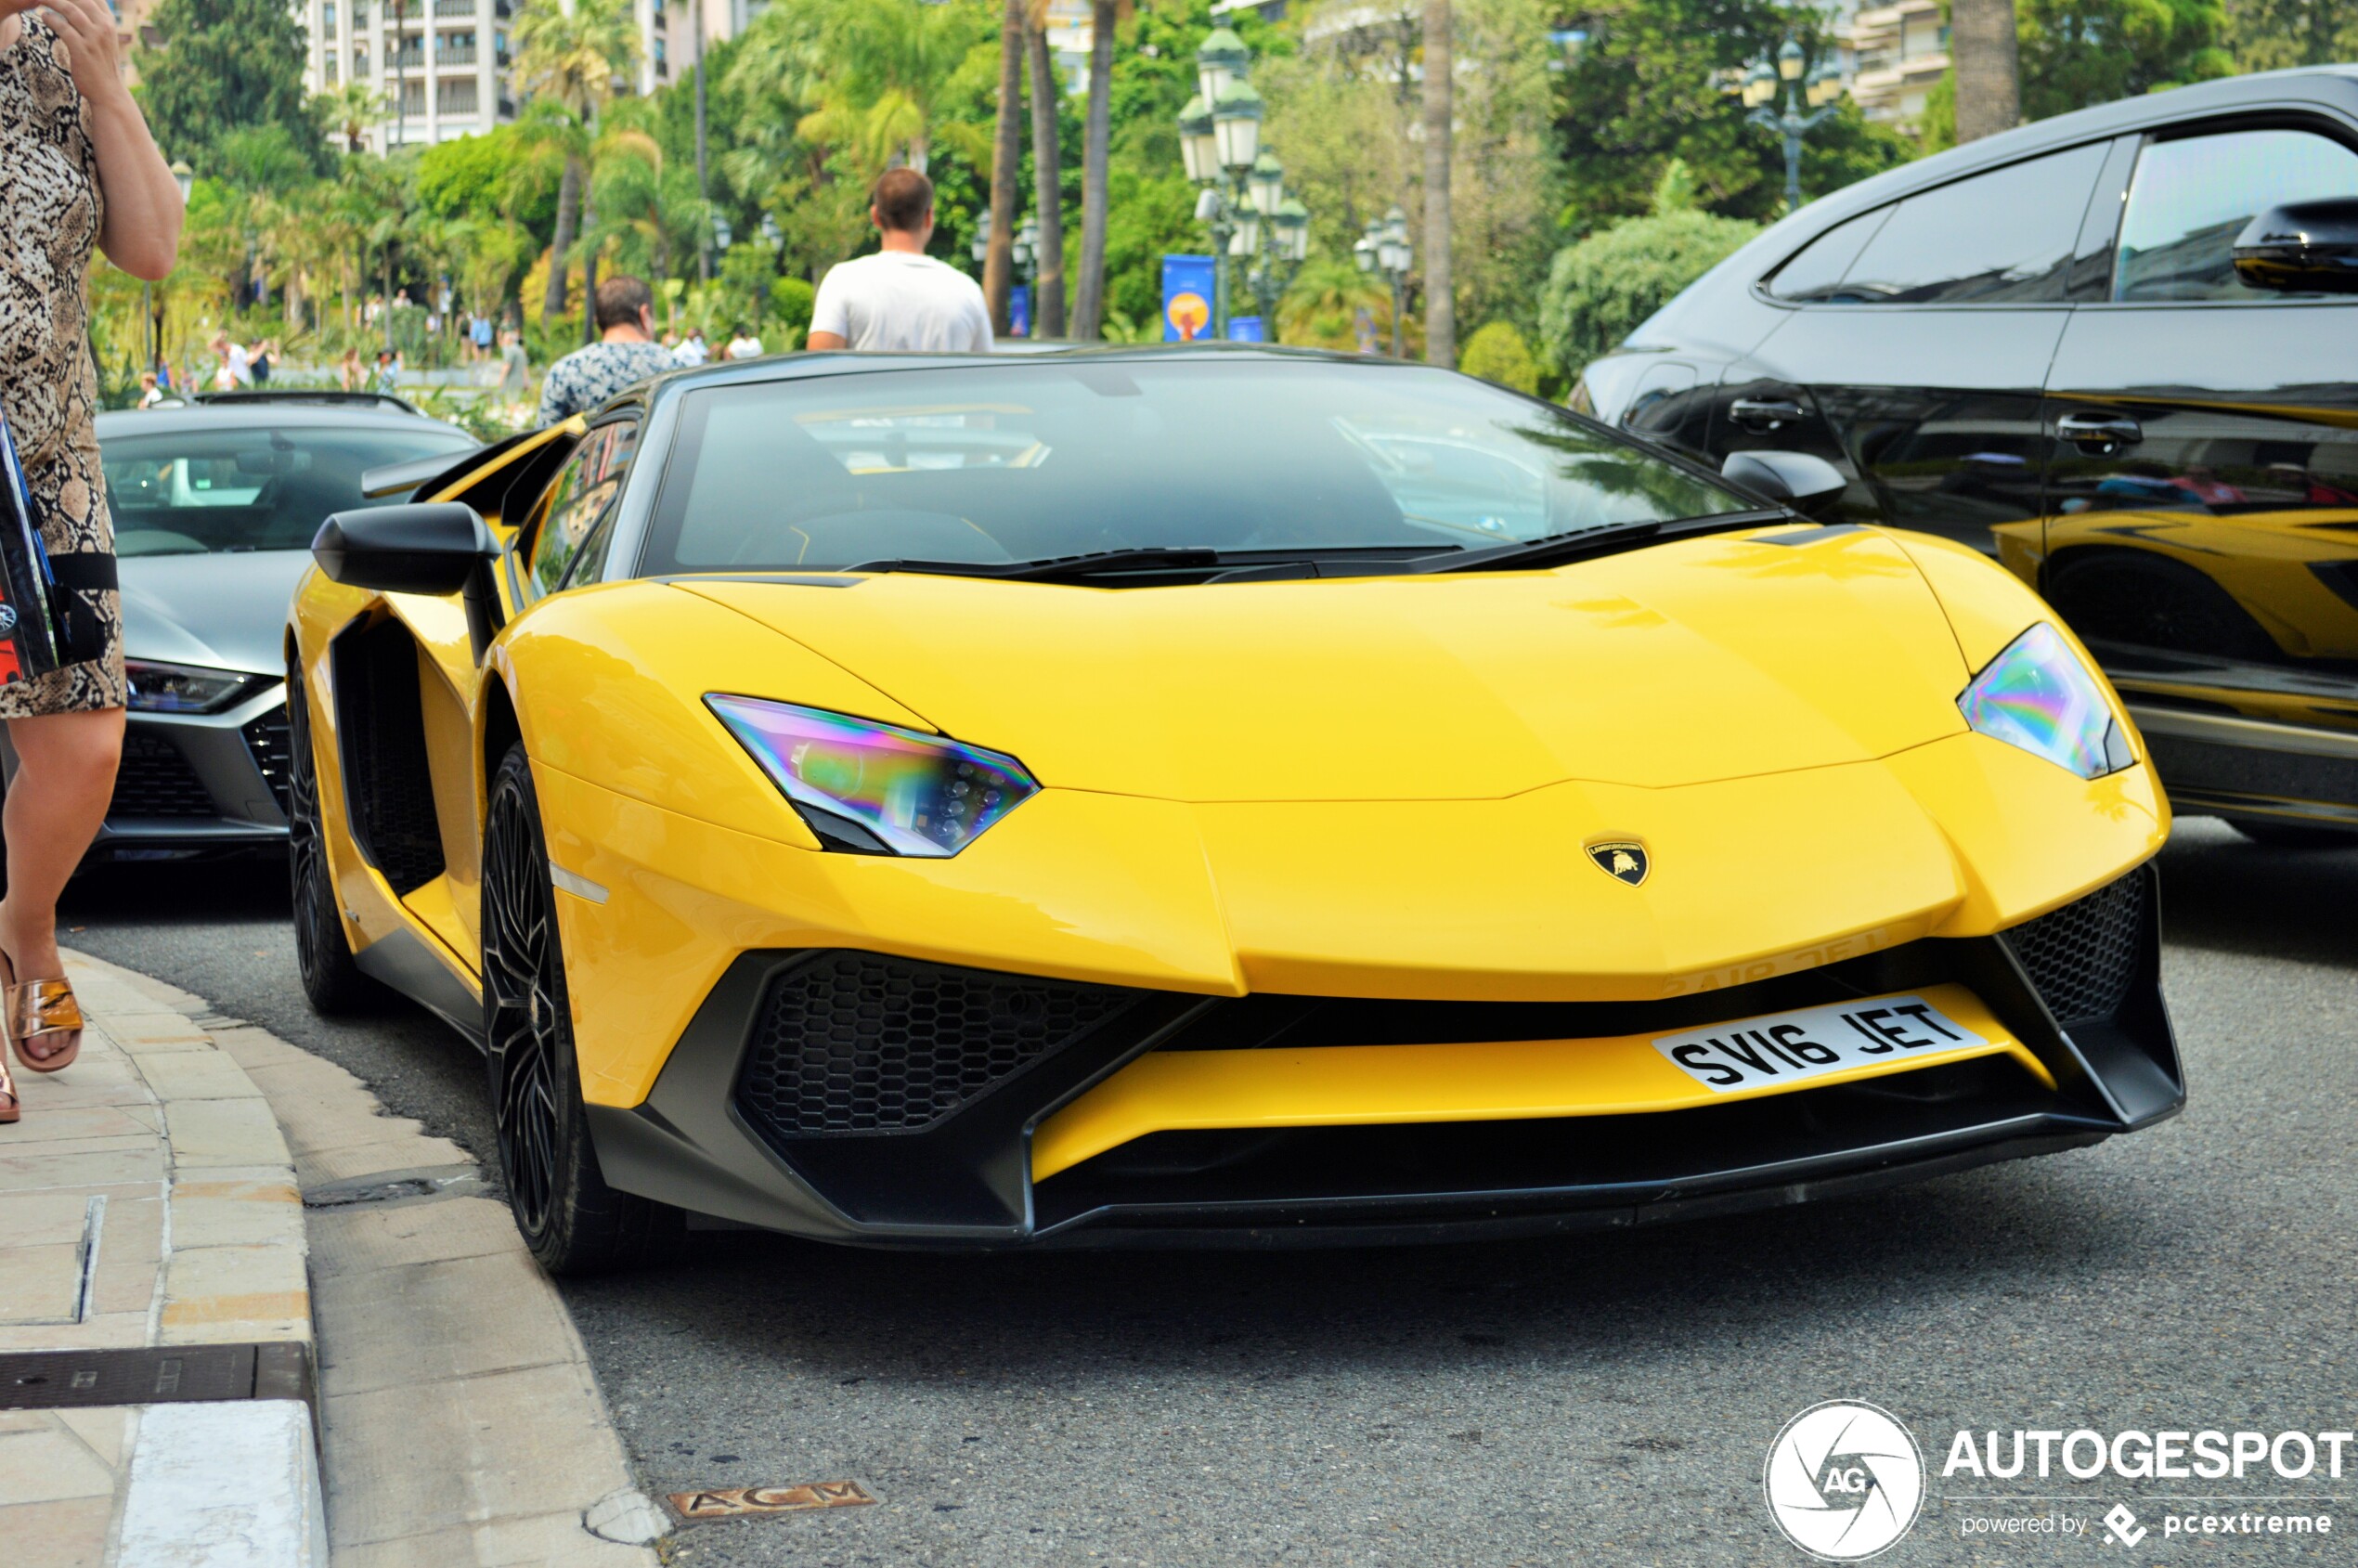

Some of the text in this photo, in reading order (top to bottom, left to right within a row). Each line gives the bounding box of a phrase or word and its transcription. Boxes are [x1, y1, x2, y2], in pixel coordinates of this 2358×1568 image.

[1589, 843, 1641, 855] LAMBORGHINI
[1671, 1004, 1963, 1086] SV16 JET
[689, 1482, 869, 1511] ACM
